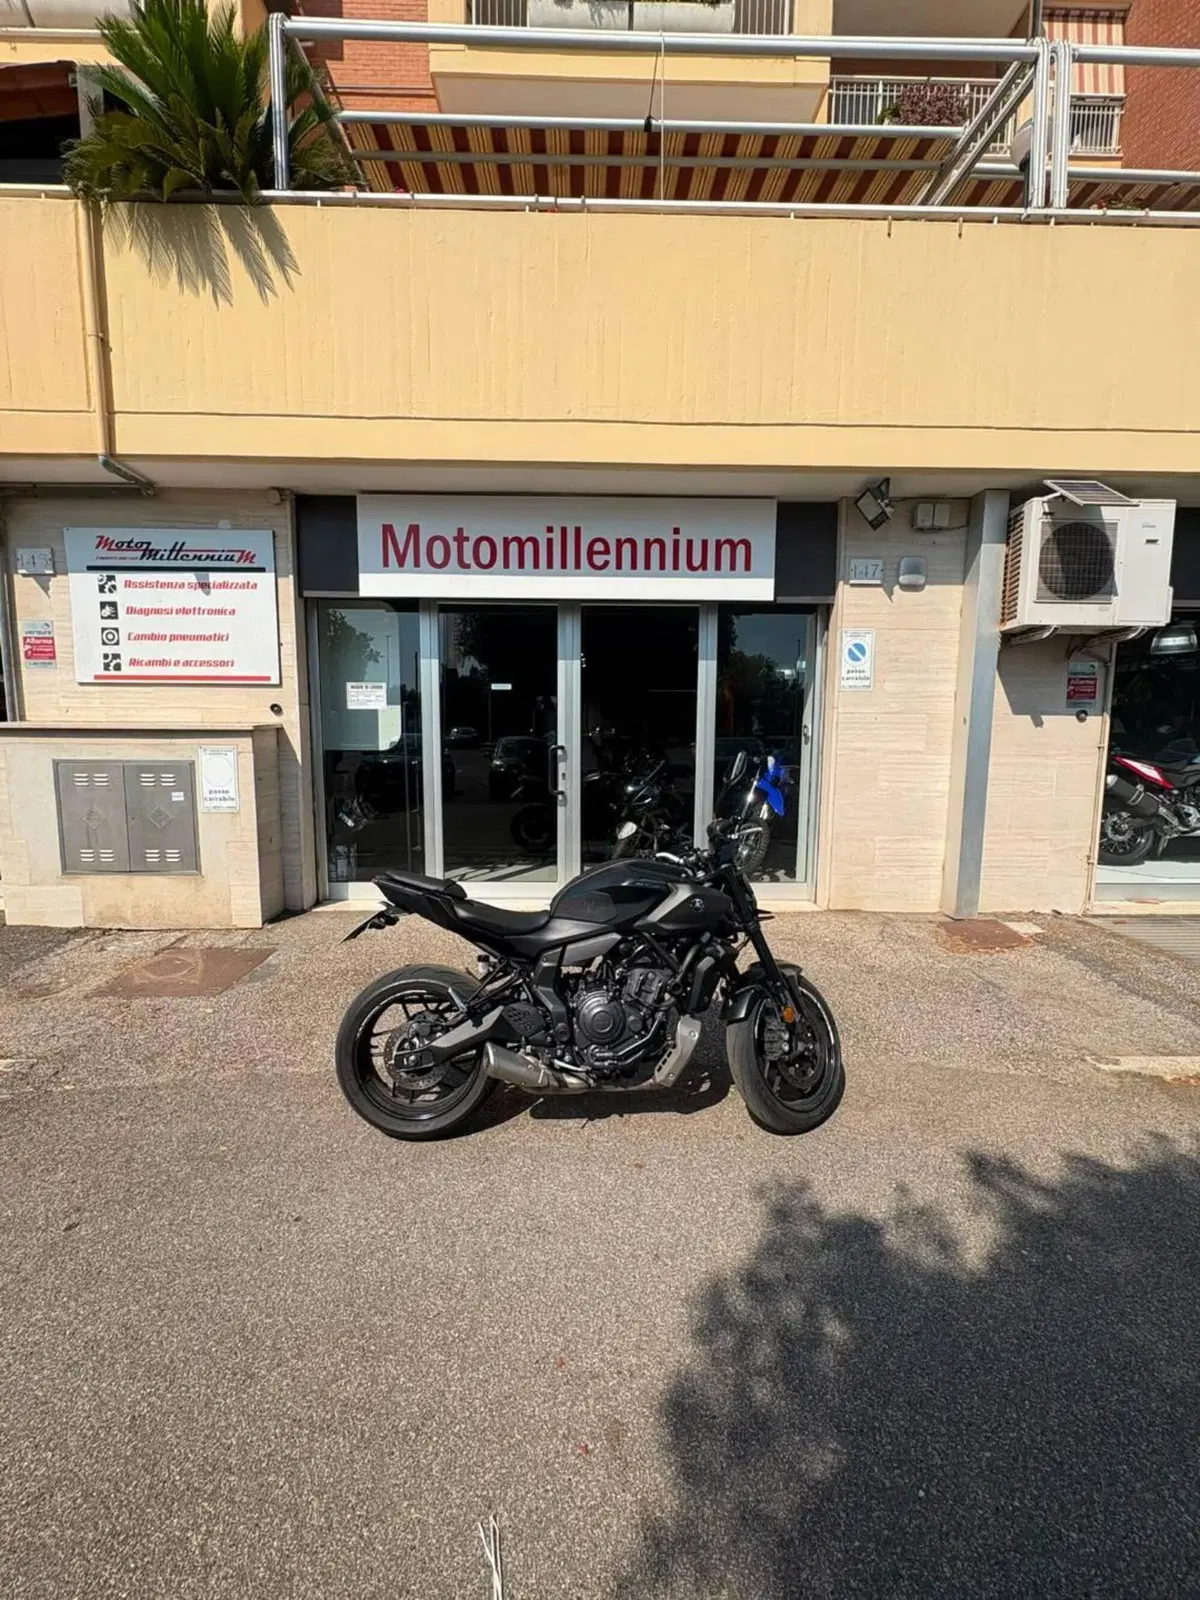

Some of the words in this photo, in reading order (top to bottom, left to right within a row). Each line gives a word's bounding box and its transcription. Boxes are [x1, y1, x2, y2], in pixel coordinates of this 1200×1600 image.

[95, 535, 152, 551] Moto
[381, 523, 752, 572] Motomillennium
[124, 580, 186, 590] Assistenza
[187, 580, 258, 591] specializzata
[126, 606, 173, 617] Diagnosi
[175, 607, 236, 616] elettronica
[127, 632, 168, 642] Cambio
[169, 633, 229, 643] pneumatici
[128, 658, 172, 667] Ricambi
[182, 659, 235, 668] accessori
